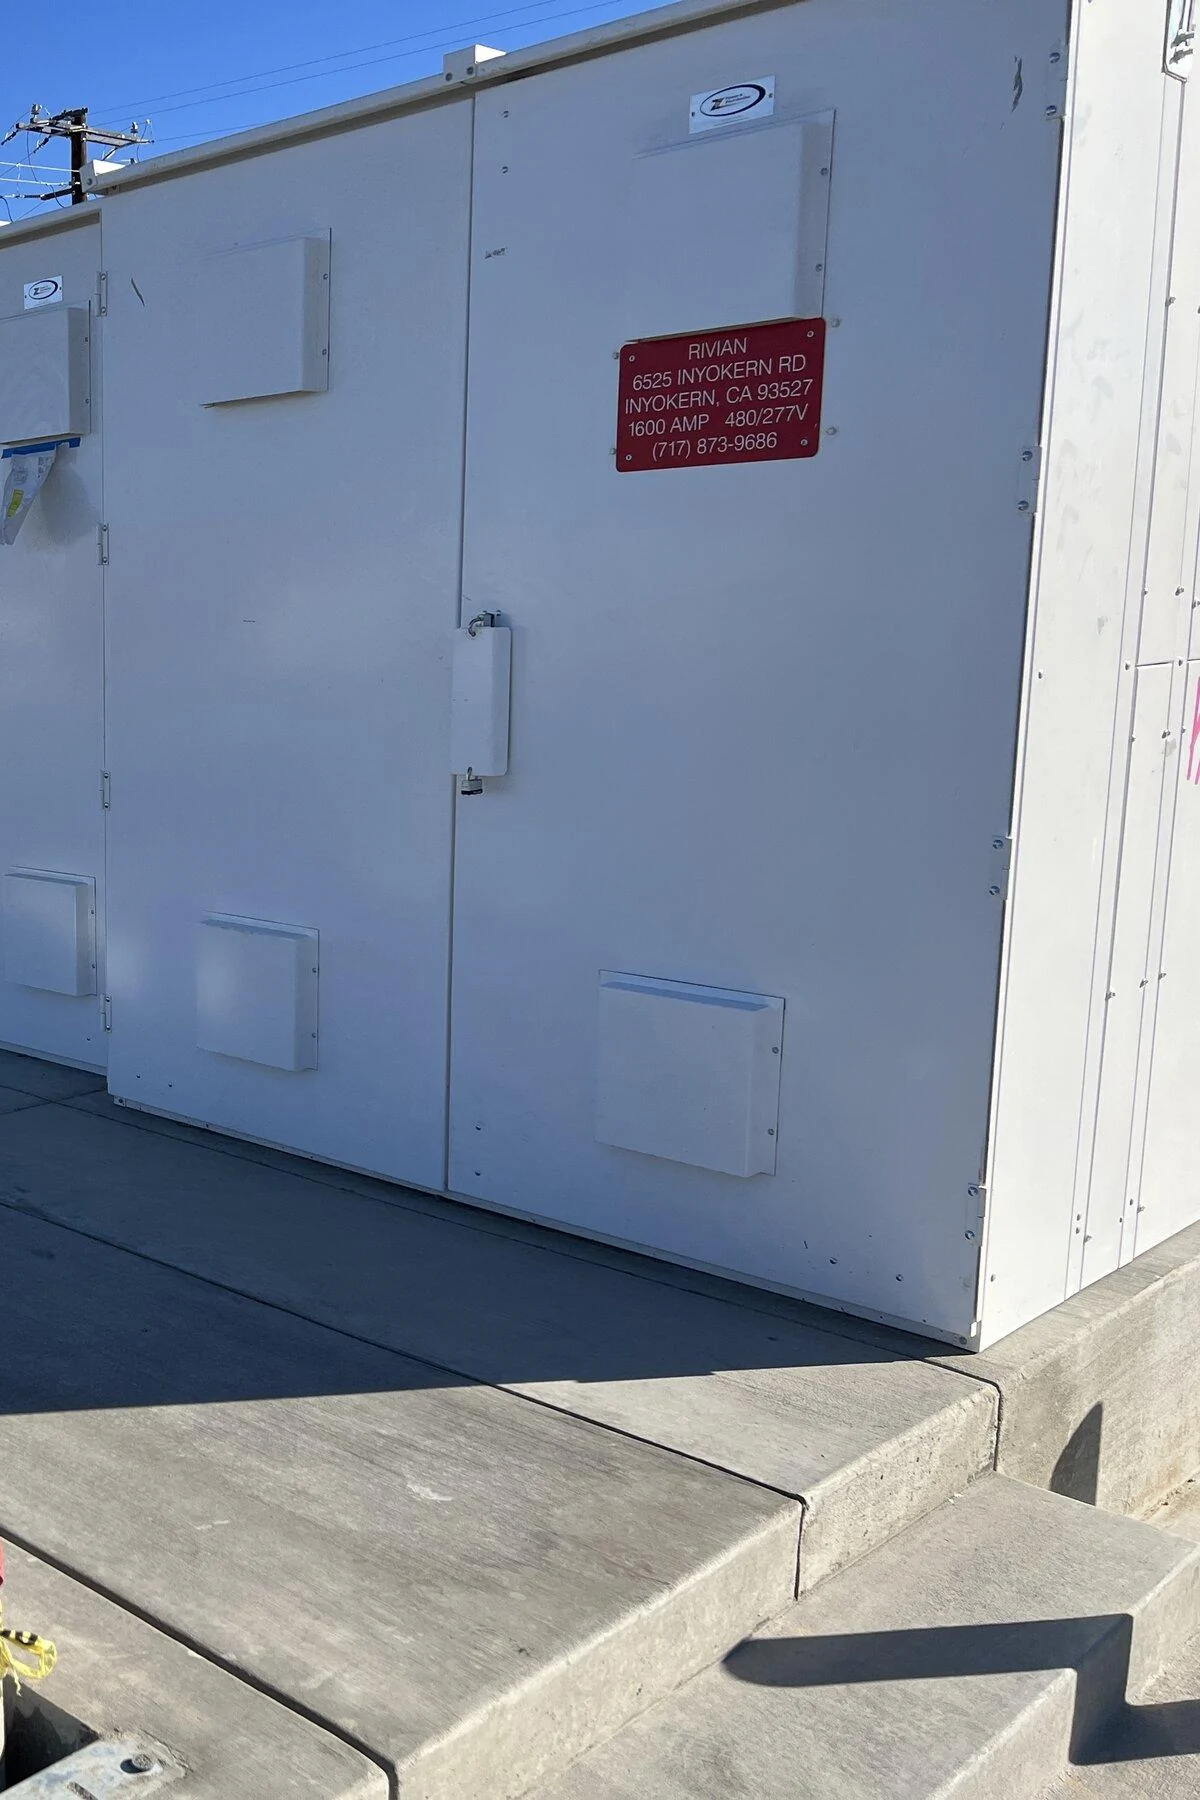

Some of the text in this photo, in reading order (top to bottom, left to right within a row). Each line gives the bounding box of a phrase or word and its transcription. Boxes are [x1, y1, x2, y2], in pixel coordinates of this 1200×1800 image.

[688, 336, 748, 360] RIVIAN
[632, 354, 806, 391] 6525 INYOKERN RD
[625, 379, 813, 414] INYOKERN, CA 93527
[628, 404, 809, 437] 1600 AMP 480/277V
[652, 432, 778, 462] (717) 873-9686
